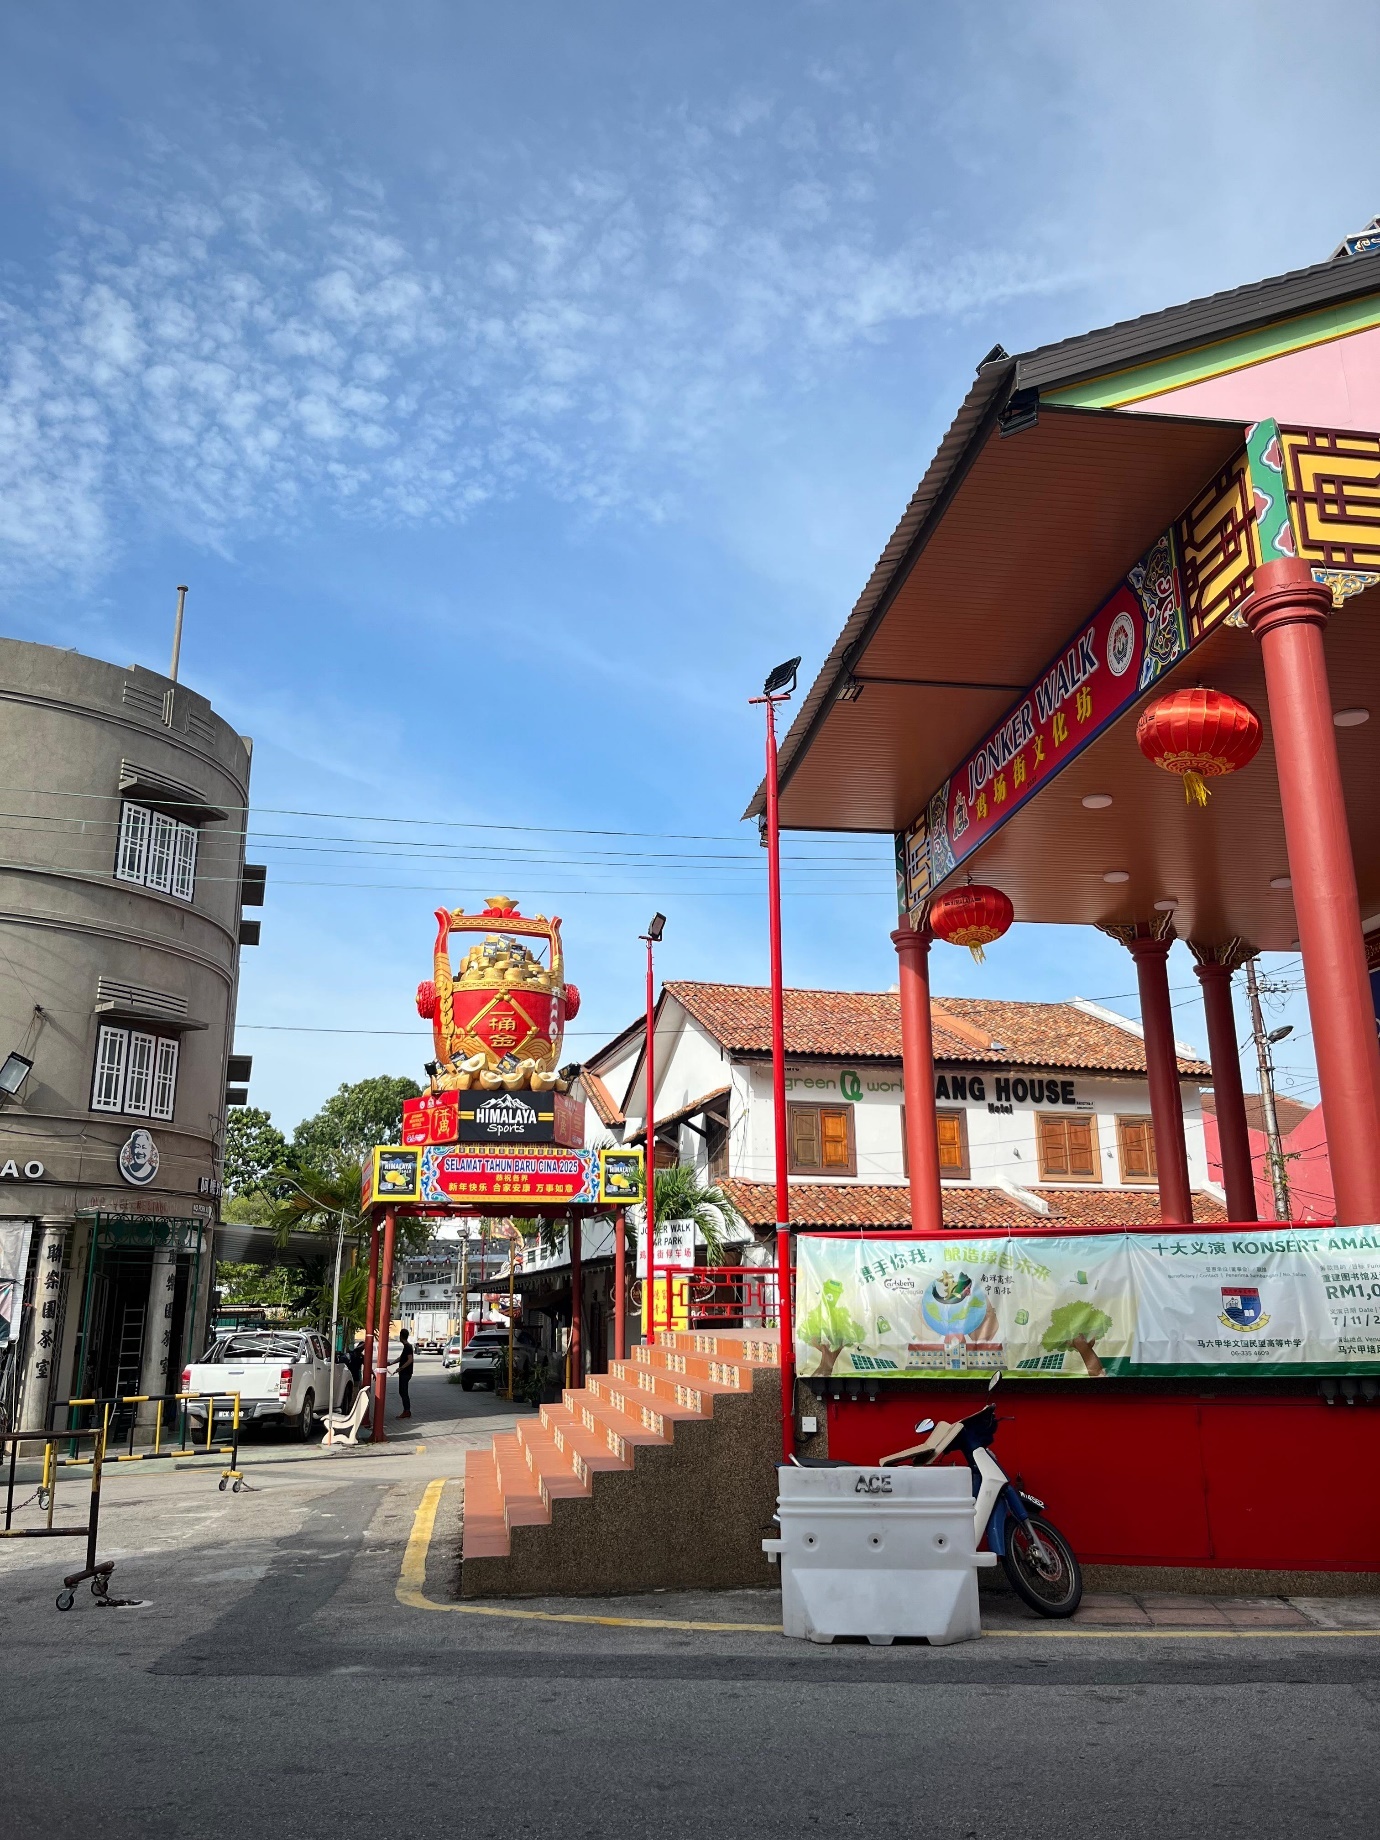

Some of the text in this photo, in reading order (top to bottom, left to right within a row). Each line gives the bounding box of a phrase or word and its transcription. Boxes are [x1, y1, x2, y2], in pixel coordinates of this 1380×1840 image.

[968, 627, 1100, 806] JONKER WALK
[975, 686, 1092, 821] 鸡场街文化坊
[489, 1010, 517, 1048] 一桶金
[785, 1077, 837, 1091] green
[866, 1078, 905, 1093] worl
[995, 1077, 1077, 1105] HOUSE
[476, 1108, 537, 1125] HIMALAYA
[487, 1123, 525, 1136] Sports
[0, 1159, 45, 1179] AO
[445, 1158, 578, 1174] SELAMAT TAHUN BARU CINA 2025
[449, 1182, 574, 1193] 新年快乐 合家安康 万事如意
[671, 1223, 691, 1232] WALK
[664, 1236, 682, 1246] PARK
[1151, 1235, 1380, 1257] 十大义演 KONSERT AMAL
[640, 1247, 692, 1260] 鸡街停车场
[943, 1246, 1053, 1283] 酿造绿色未来
[883, 1277, 915, 1292] Carlsberg
[1321, 1272, 1380, 1283] 重建图书馆及
[1197, 1338, 1302, 1348] 马六甲华文国民型高等中学
[855, 1474, 893, 1493] ACE
